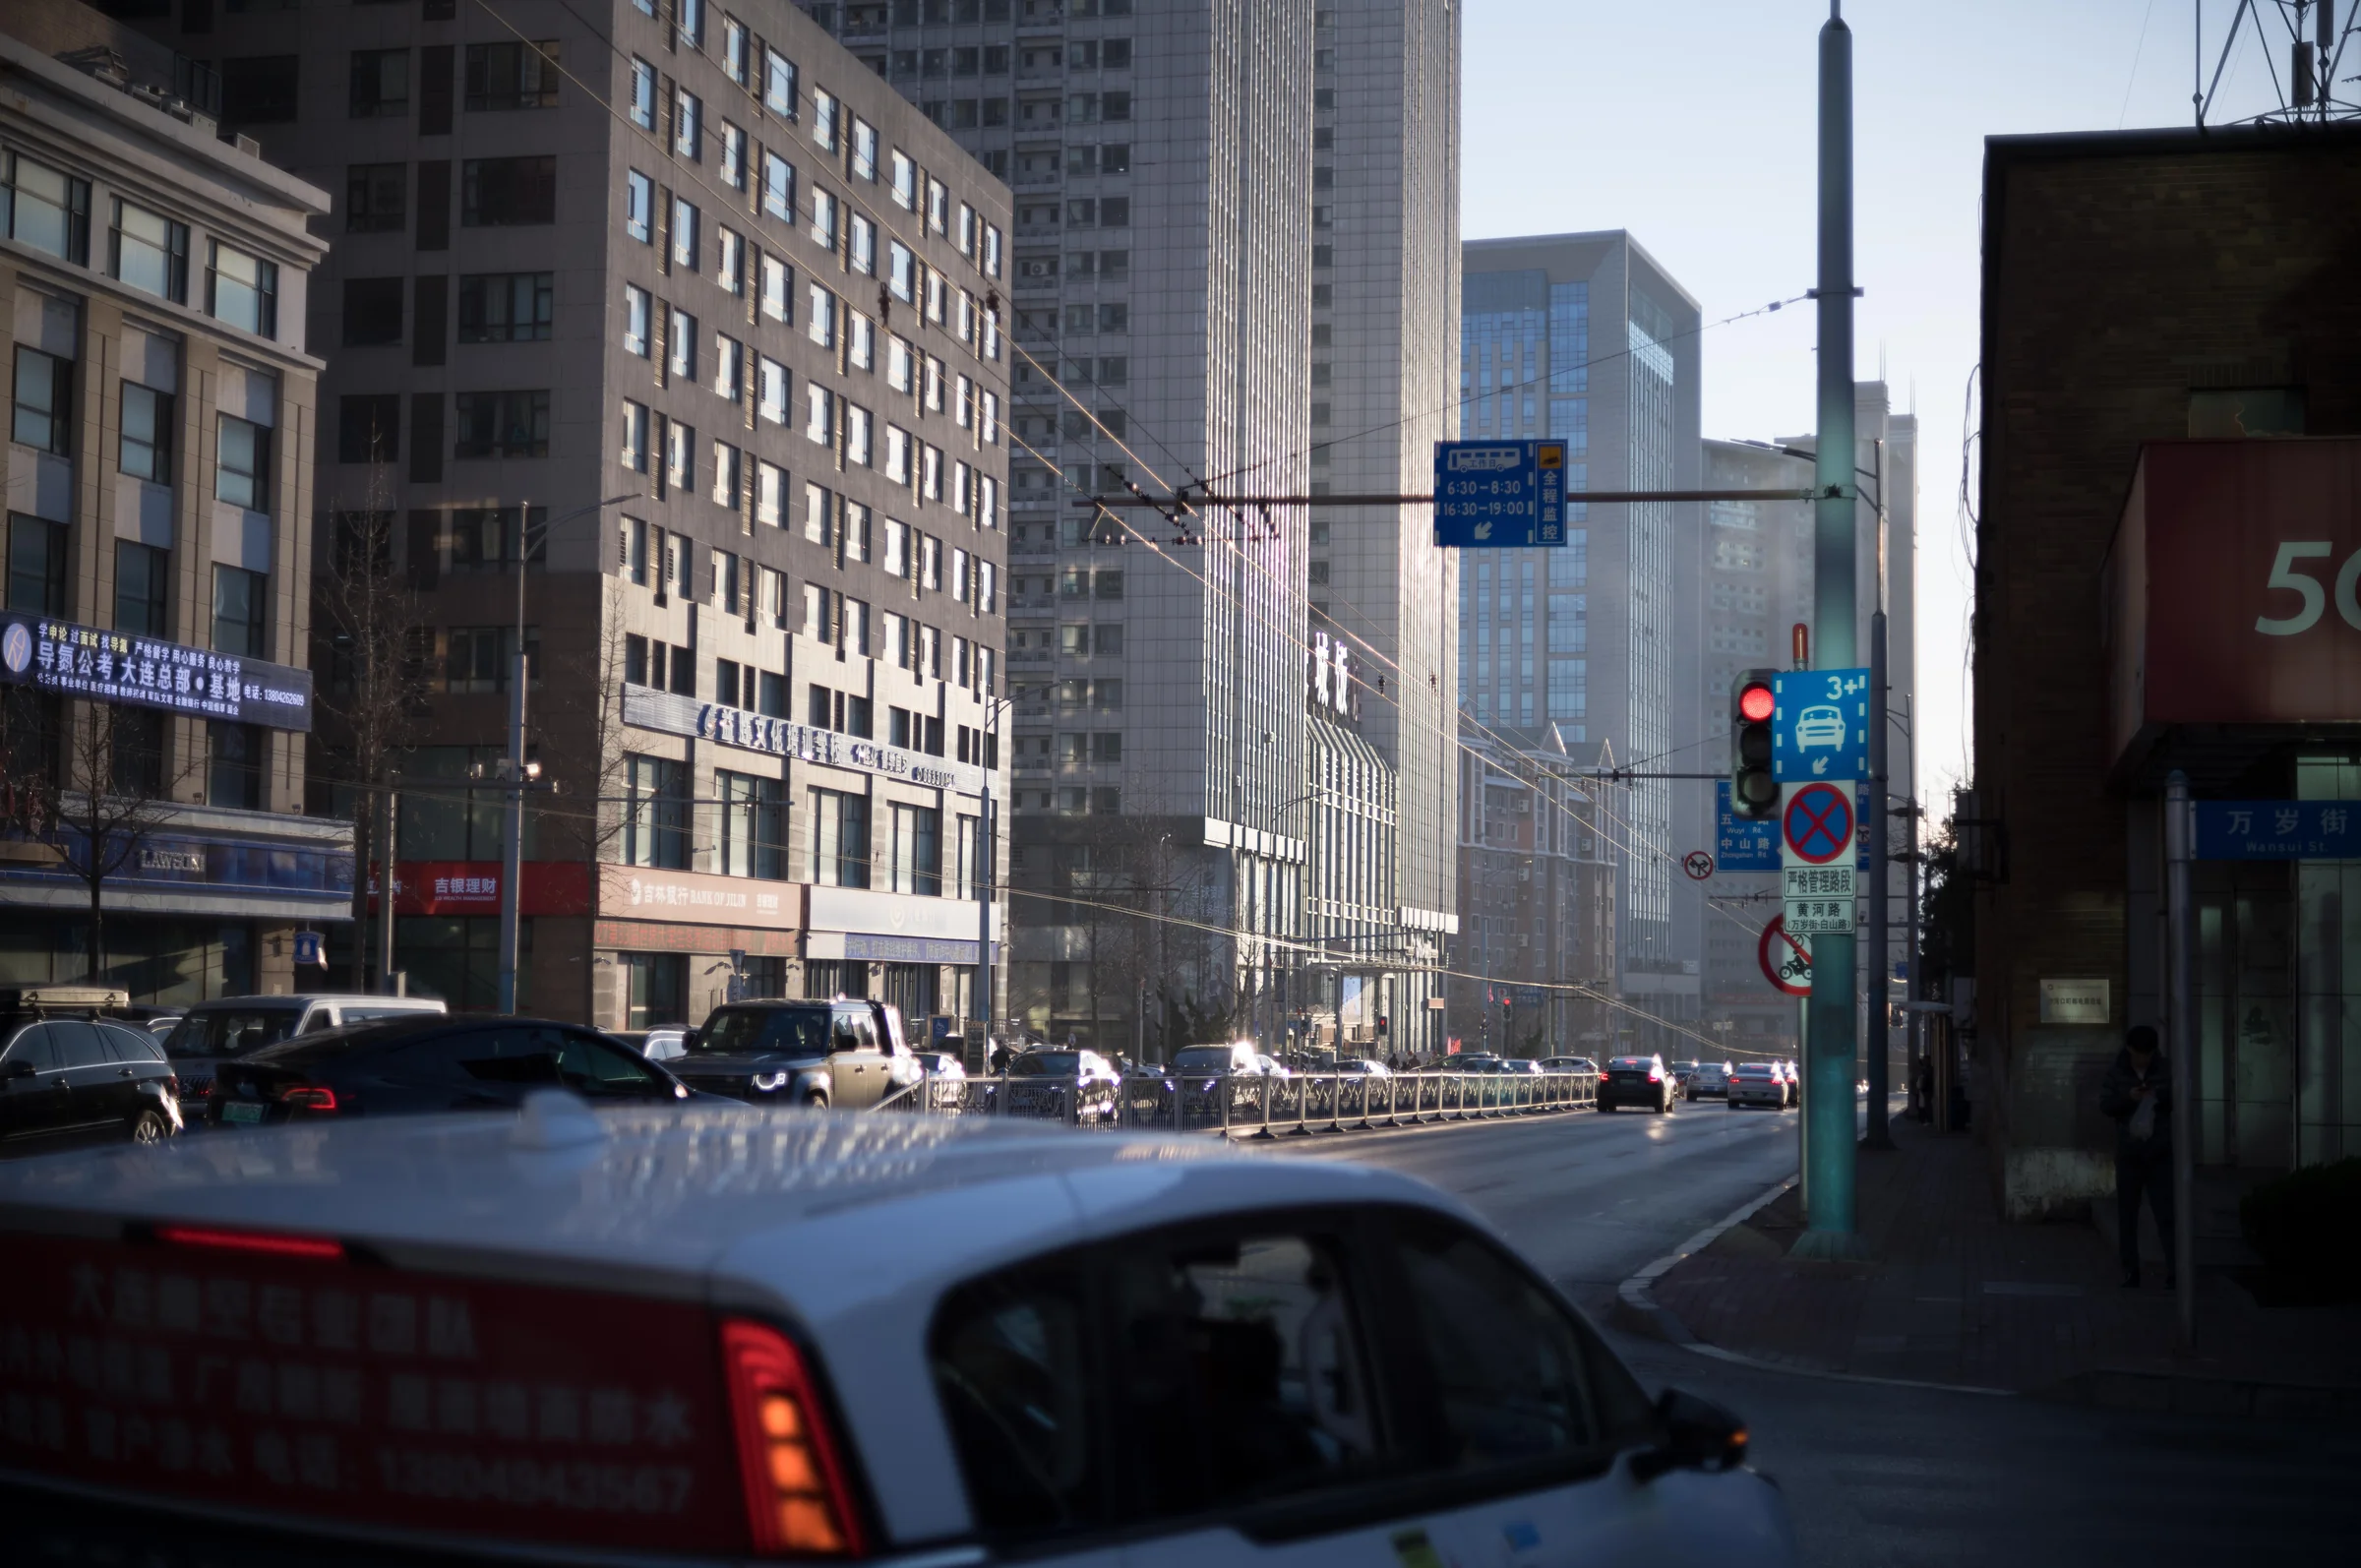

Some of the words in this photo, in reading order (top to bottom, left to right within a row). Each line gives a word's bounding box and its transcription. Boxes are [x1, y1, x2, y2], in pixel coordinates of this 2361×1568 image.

[1469, 458, 1496, 468] 工作日
[1543, 470, 1557, 540] 全程监控
[1827, 676, 1858, 700] 3+
[2225, 807, 2348, 837] 万岁街
[1721, 837, 1770, 850] 中山路
[2245, 840, 2302, 853] Wansui
[2308, 840, 2330, 853] St.
[141, 850, 201, 873] LAWSON
[435, 877, 497, 894] 吉银理财
[1787, 870, 1850, 894] 严格管理路段
[644, 883, 689, 906] 吉林银行
[691, 889, 713, 906] BANK
[714, 890, 726, 906] OF
[1796, 903, 1841, 918] 黄河路
